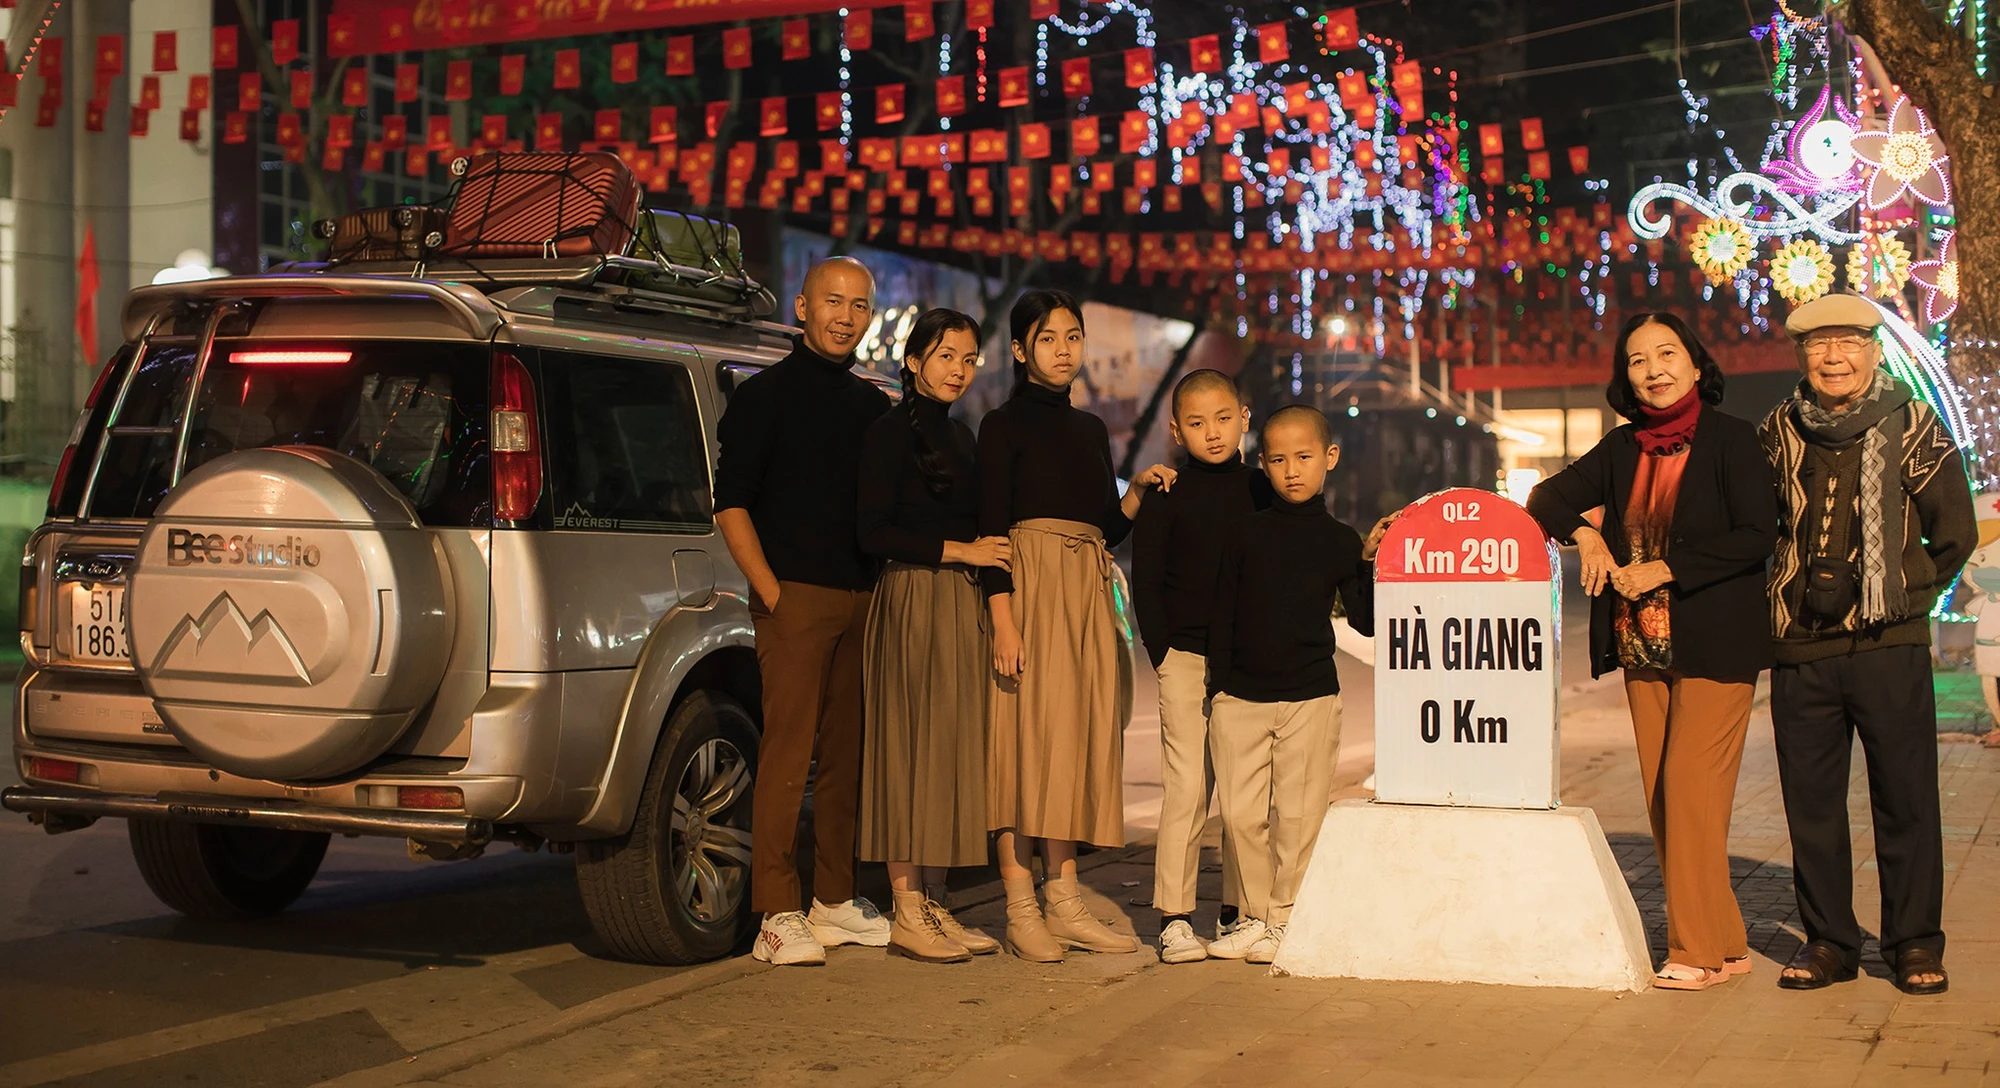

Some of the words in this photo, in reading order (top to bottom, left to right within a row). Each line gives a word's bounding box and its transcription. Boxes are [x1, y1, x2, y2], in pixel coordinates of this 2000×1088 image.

[567, 517, 619, 529] EVEREST
[1442, 502, 1481, 523] QL2
[88, 562, 112, 575] Ford
[1404, 537, 1455, 574] Km
[1460, 537, 1520, 574] 290
[1388, 605, 1431, 670] HÀ
[1442, 617, 1542, 671] GIANG
[1420, 699, 1441, 743] 0
[1453, 699, 1508, 743] Km
